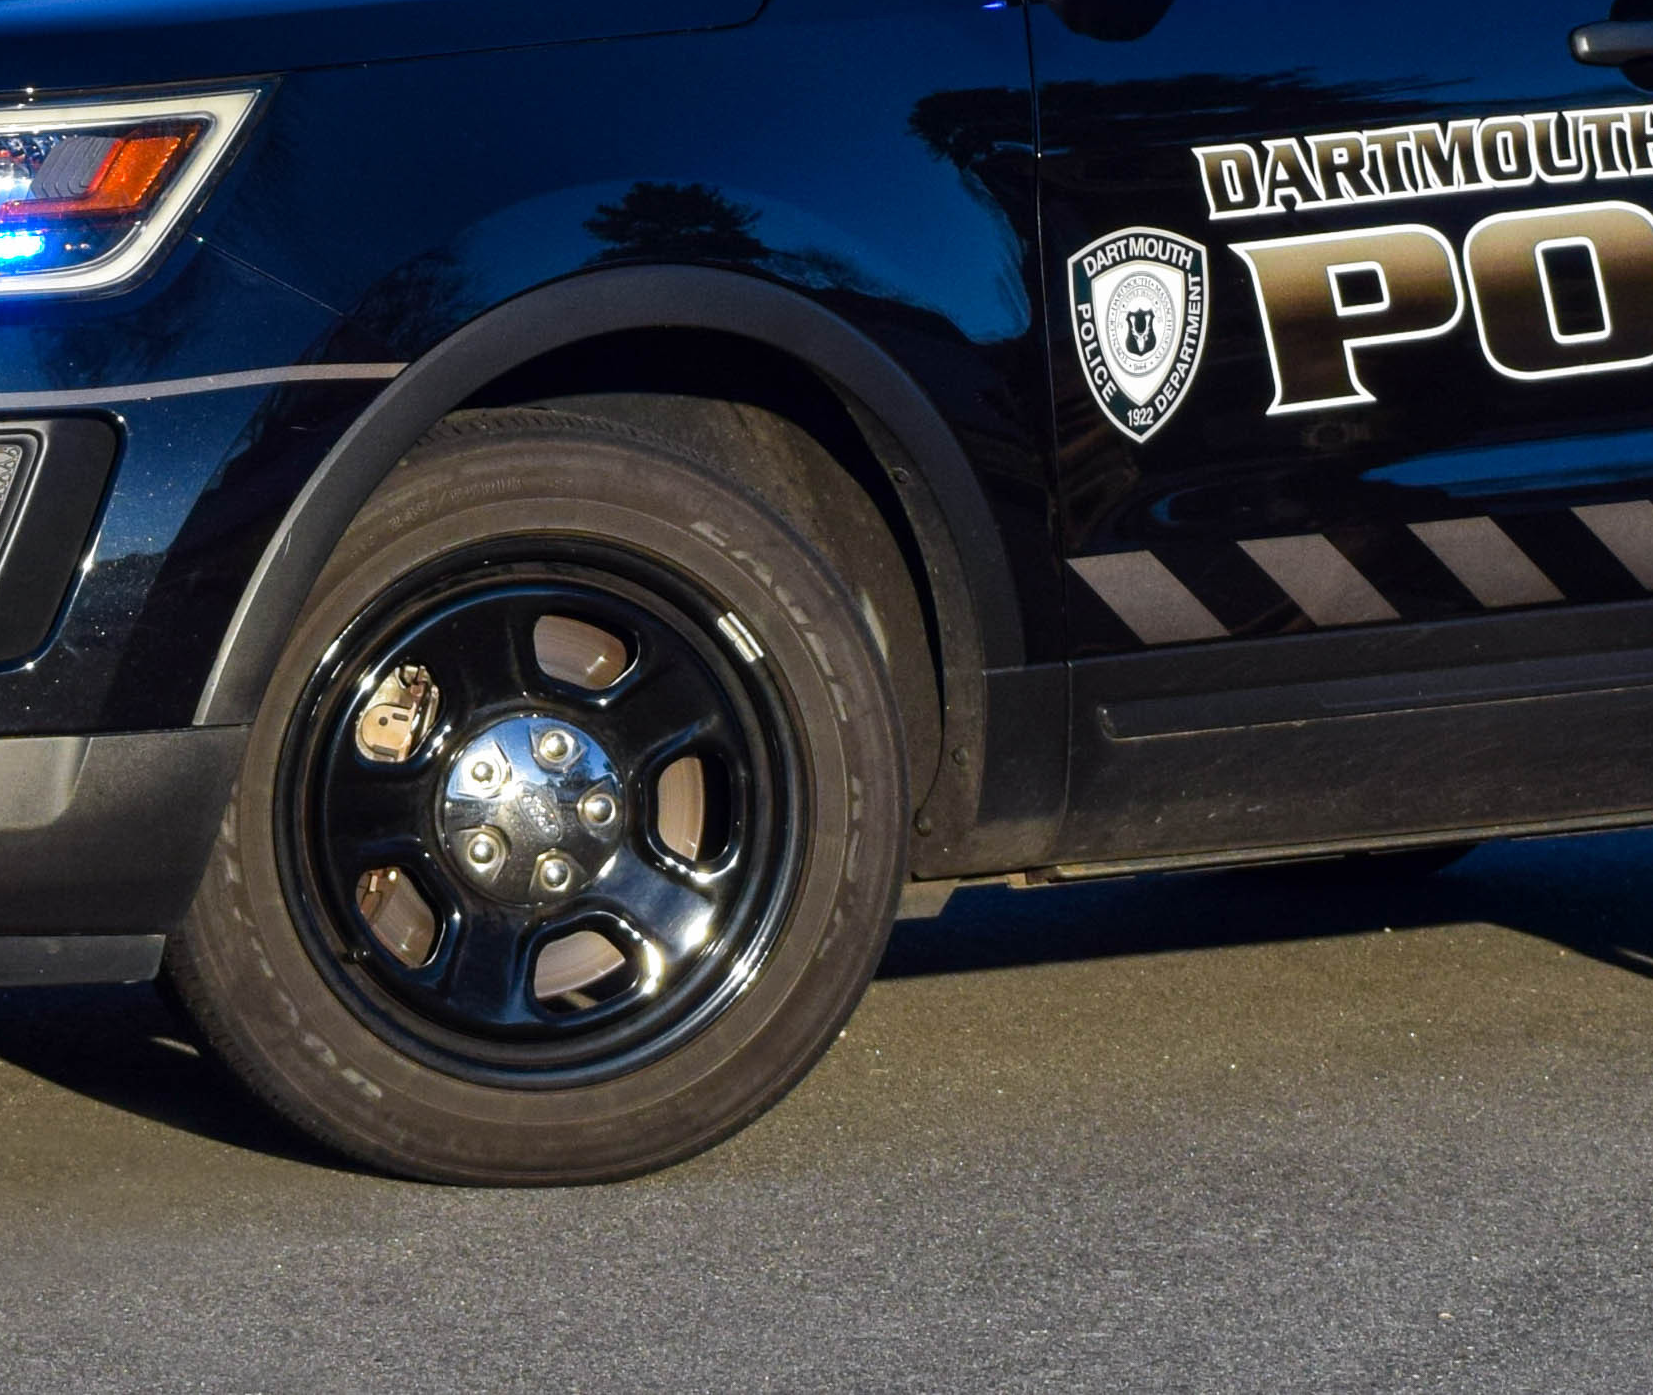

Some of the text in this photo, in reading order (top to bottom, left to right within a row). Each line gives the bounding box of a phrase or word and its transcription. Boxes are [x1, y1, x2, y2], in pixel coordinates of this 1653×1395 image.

[1082, 237, 1194, 278] DARTMOUTH
[1077, 302, 1117, 402] POLICE
[1154, 272, 1202, 413] DEPARTMENT
[1127, 406, 1155, 427] 1922
